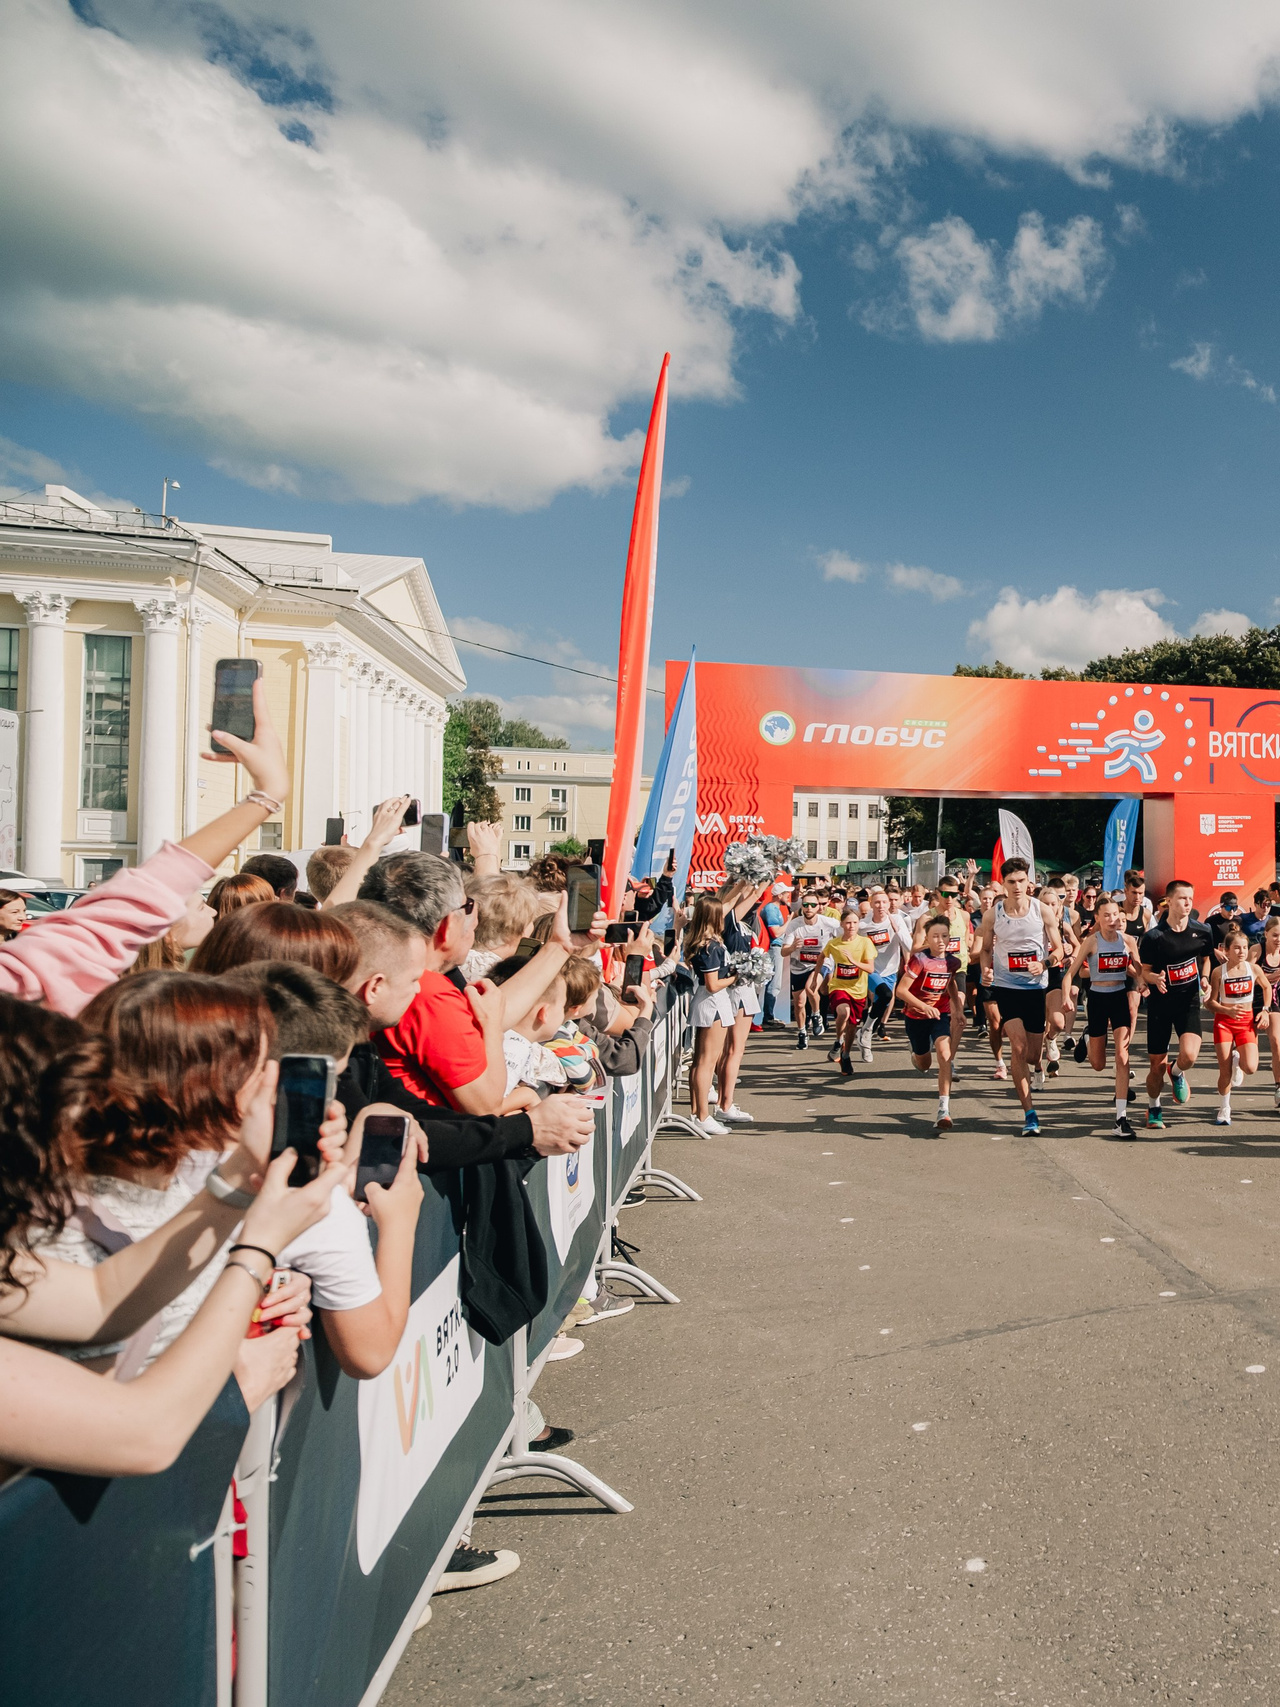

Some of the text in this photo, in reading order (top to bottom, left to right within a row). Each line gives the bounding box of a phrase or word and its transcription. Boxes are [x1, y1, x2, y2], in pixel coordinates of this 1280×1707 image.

[802, 722, 947, 749] ГЛОБУС
[728, 814, 765, 825] ВЯТКА
[738, 824, 755, 833] 2.0
[1103, 957, 1124, 966] 1492
[1173, 965, 1194, 978] 1498
[1228, 983, 1249, 991] 1279
[436, 1299, 463, 1358] ВЯТК
[446, 1342, 460, 1388] 2.0
